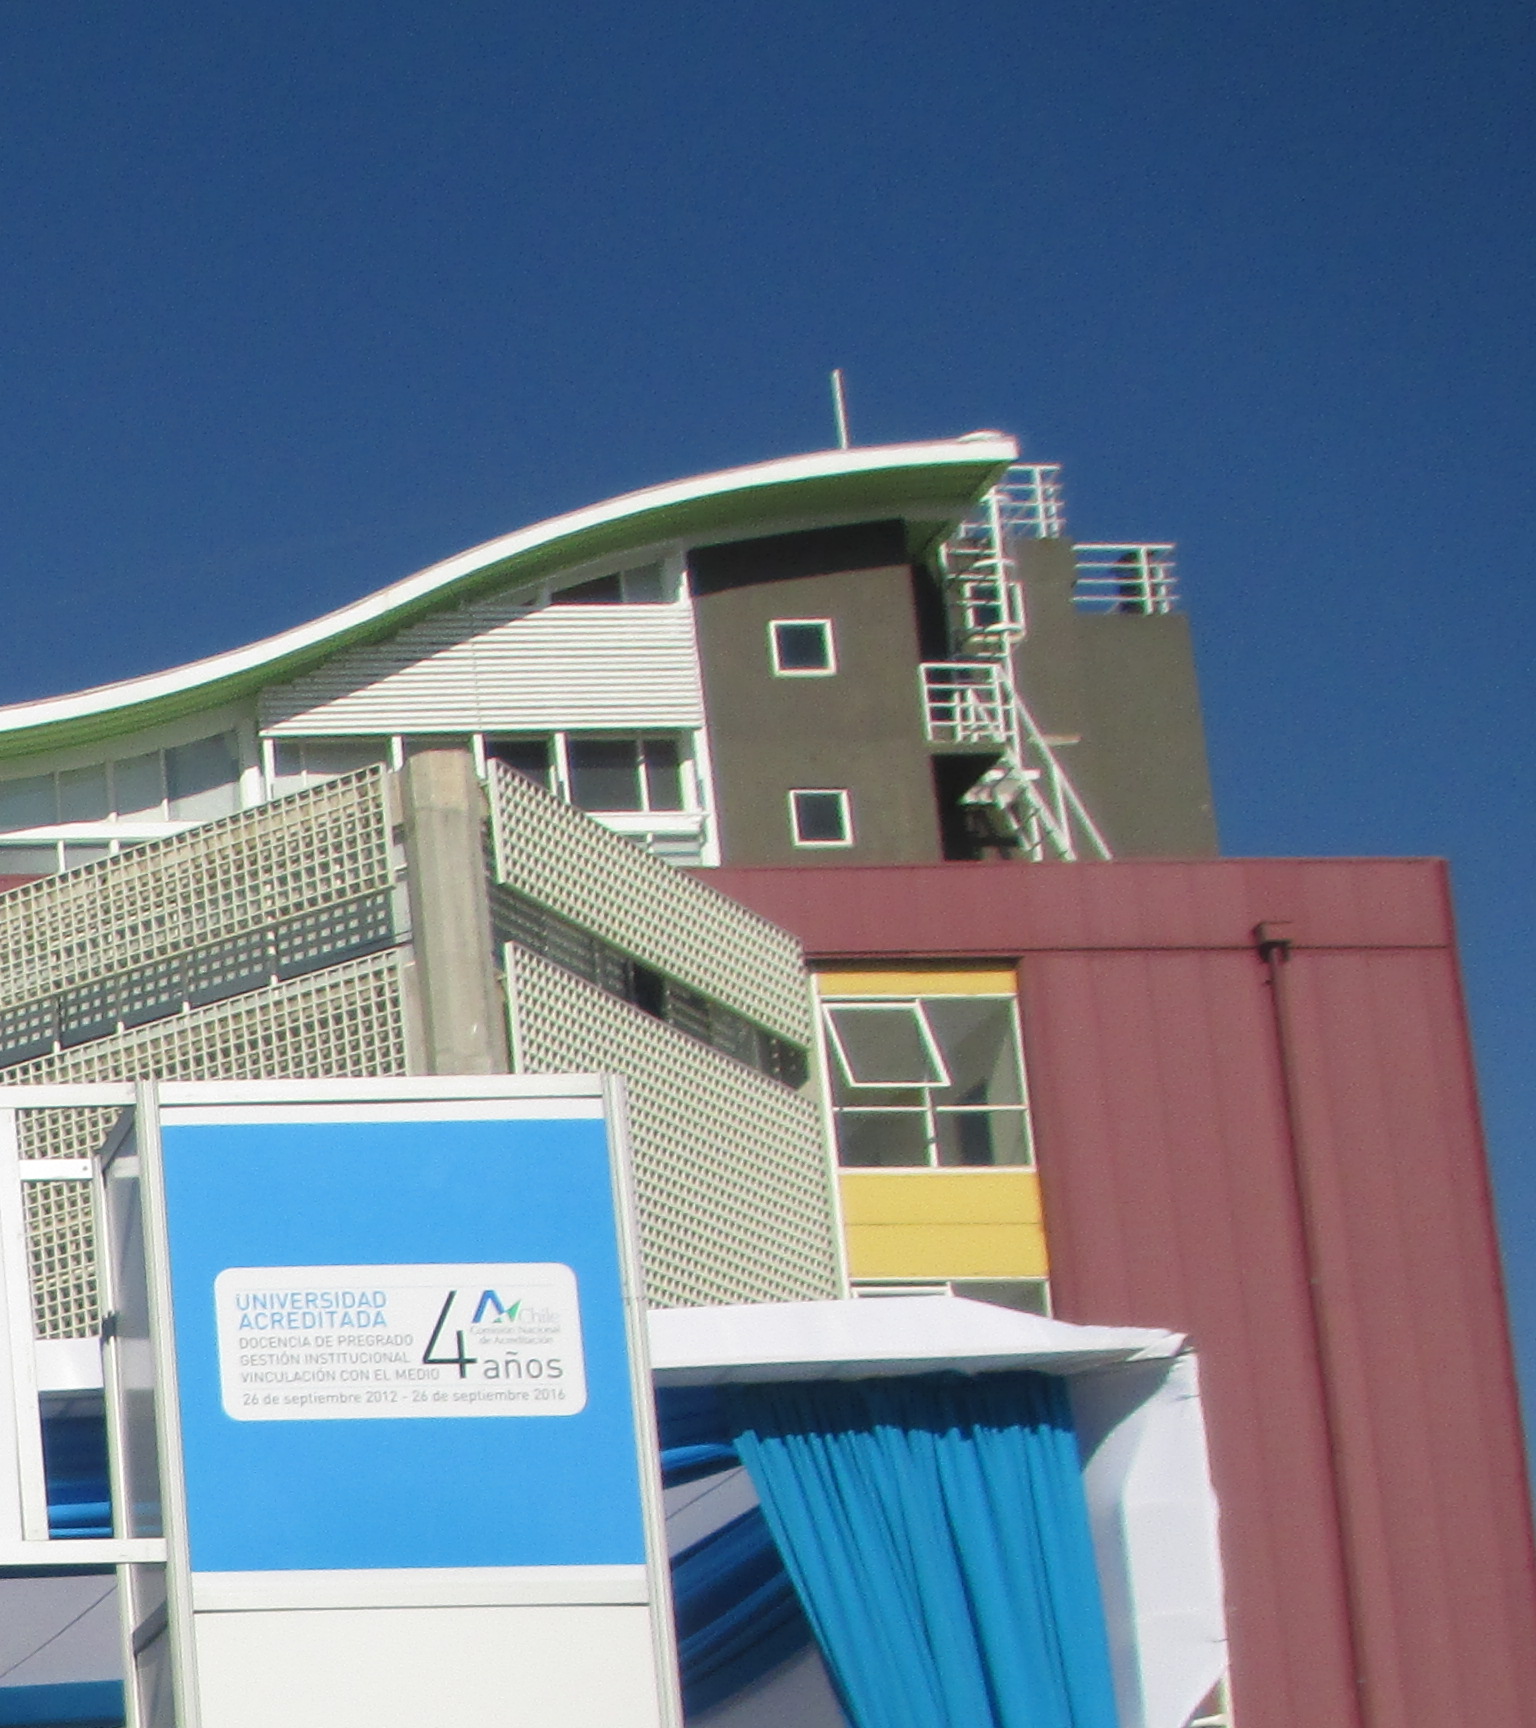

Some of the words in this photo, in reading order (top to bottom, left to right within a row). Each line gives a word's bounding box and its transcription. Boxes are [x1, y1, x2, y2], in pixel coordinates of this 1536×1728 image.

[236, 1290, 387, 1311] UNIVERSIDAD
[239, 1310, 388, 1331] ACREDITADA
[239, 1335, 311, 1350] DOCENCIA
[315, 1335, 334, 1348] DE
[338, 1333, 414, 1347] PREGRADO
[422, 1290, 478, 1379] 4
[483, 1351, 564, 1380] años
[240, 1351, 301, 1367] GESTIÓN
[305, 1351, 411, 1366] INSTITUCIONAL
[240, 1368, 336, 1384] VINCULACIÓN
[340, 1369, 370, 1382] CON
[375, 1369, 392, 1381] EL
[396, 1367, 440, 1381] MEDIO
[243, 1393, 259, 1406] 26
[263, 1392, 279, 1405] de
[284, 1390, 362, 1407] septiembre
[366, 1390, 398, 1403] 2012
[412, 1390, 428, 1403] 26
[433, 1389, 449, 1402] de
[452, 1387, 530, 1404] septiembre
[534, 1387, 566, 1401] 2016
